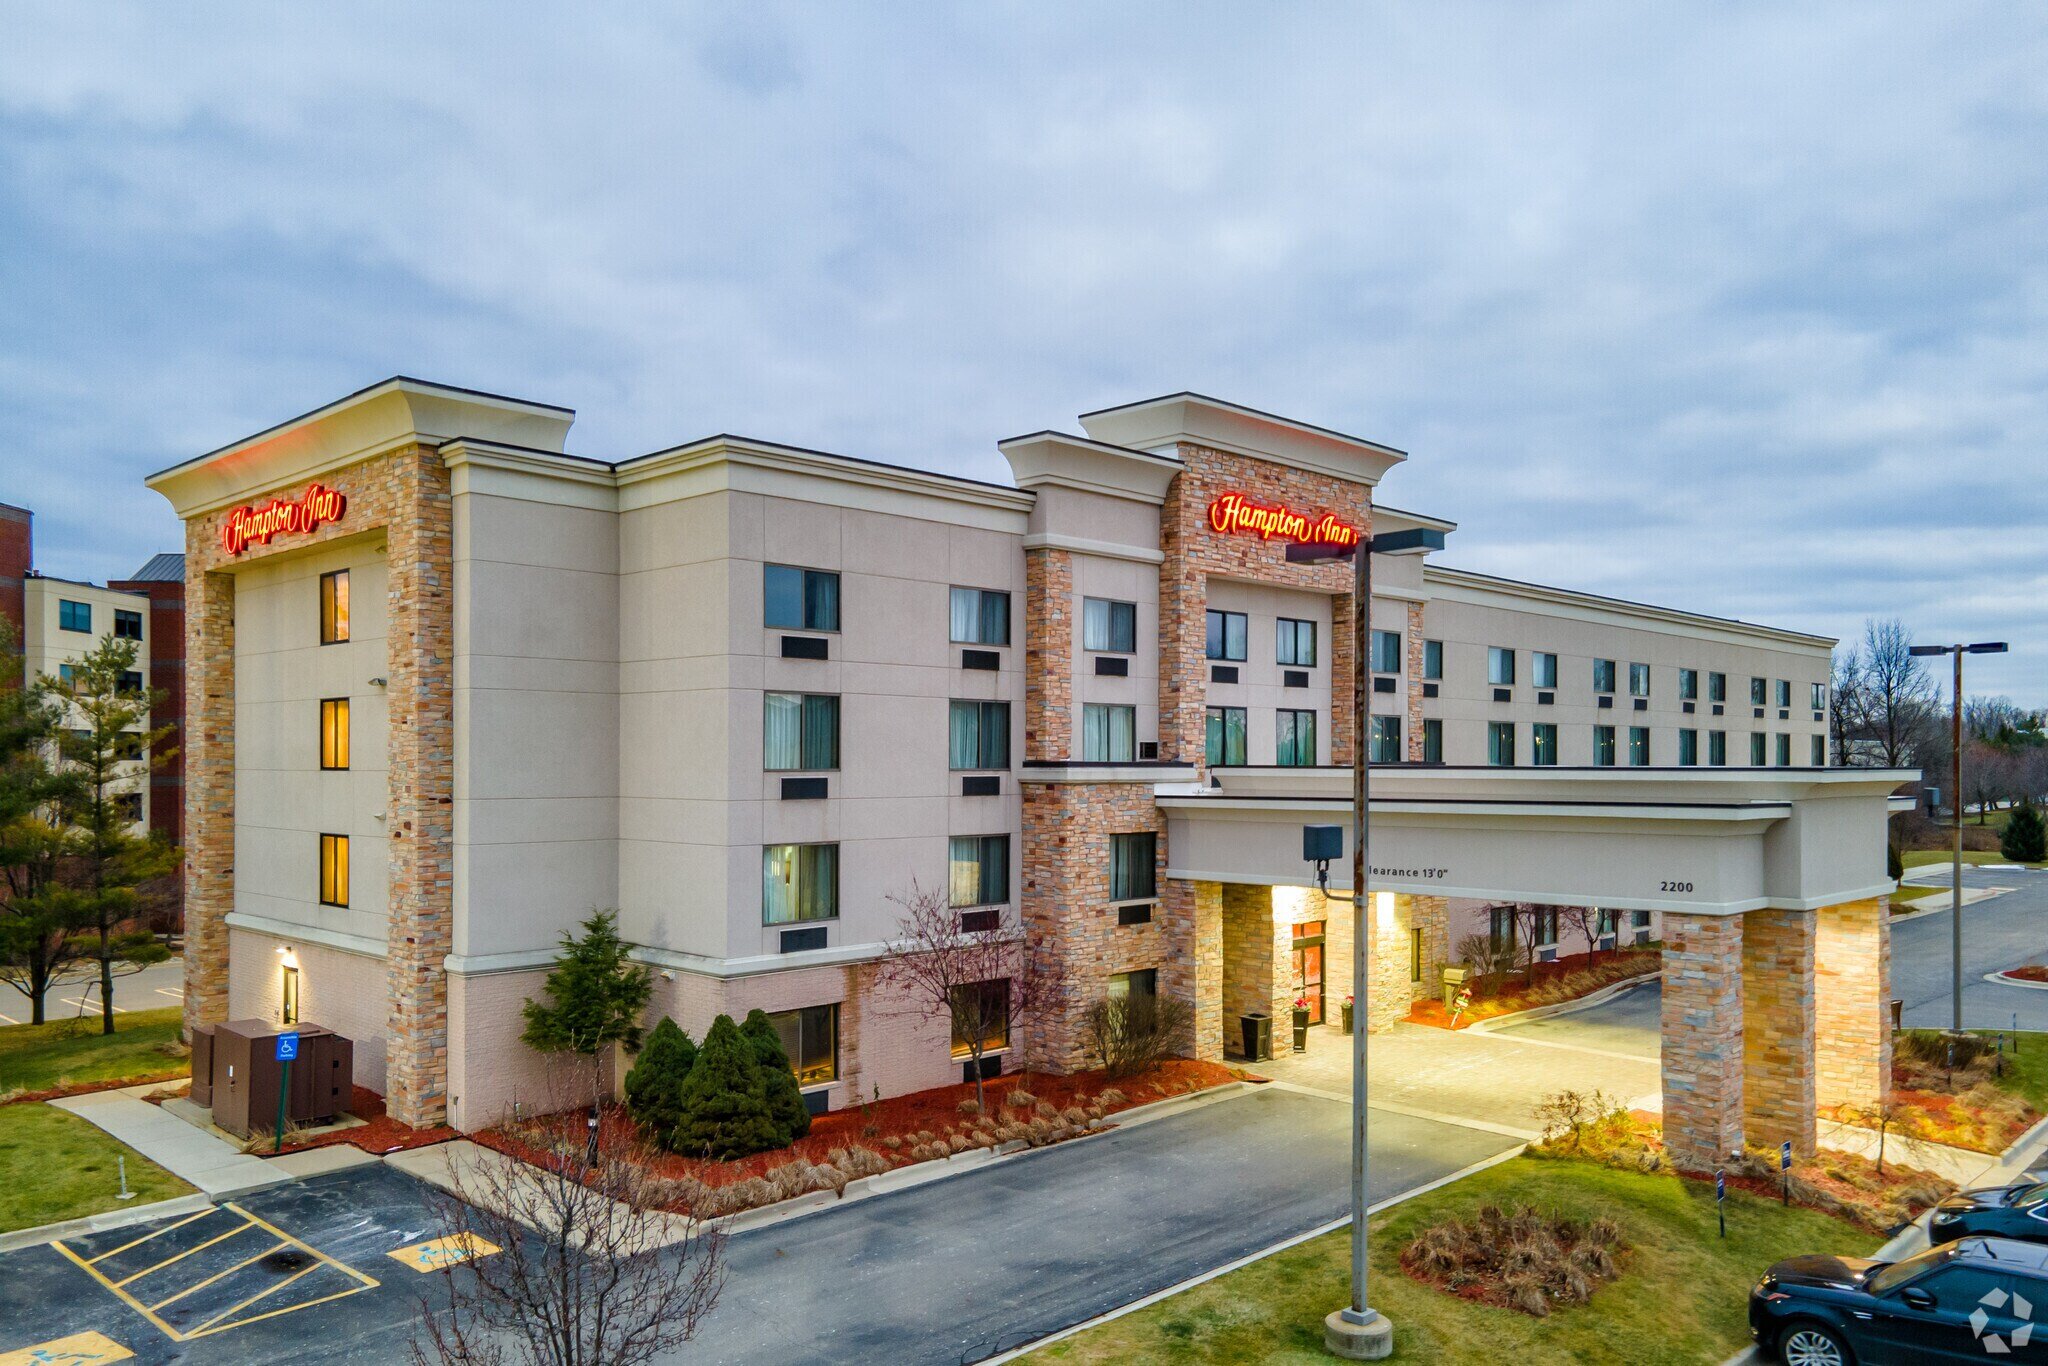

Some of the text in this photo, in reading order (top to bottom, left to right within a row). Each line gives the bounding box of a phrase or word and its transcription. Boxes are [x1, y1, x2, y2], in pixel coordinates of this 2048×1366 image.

[223, 484, 342, 555] Hampton Inn
[1210, 494, 1359, 545] Hampton Inn
[1368, 865, 1419, 877] learance
[1660, 881, 1693, 893] 2200
